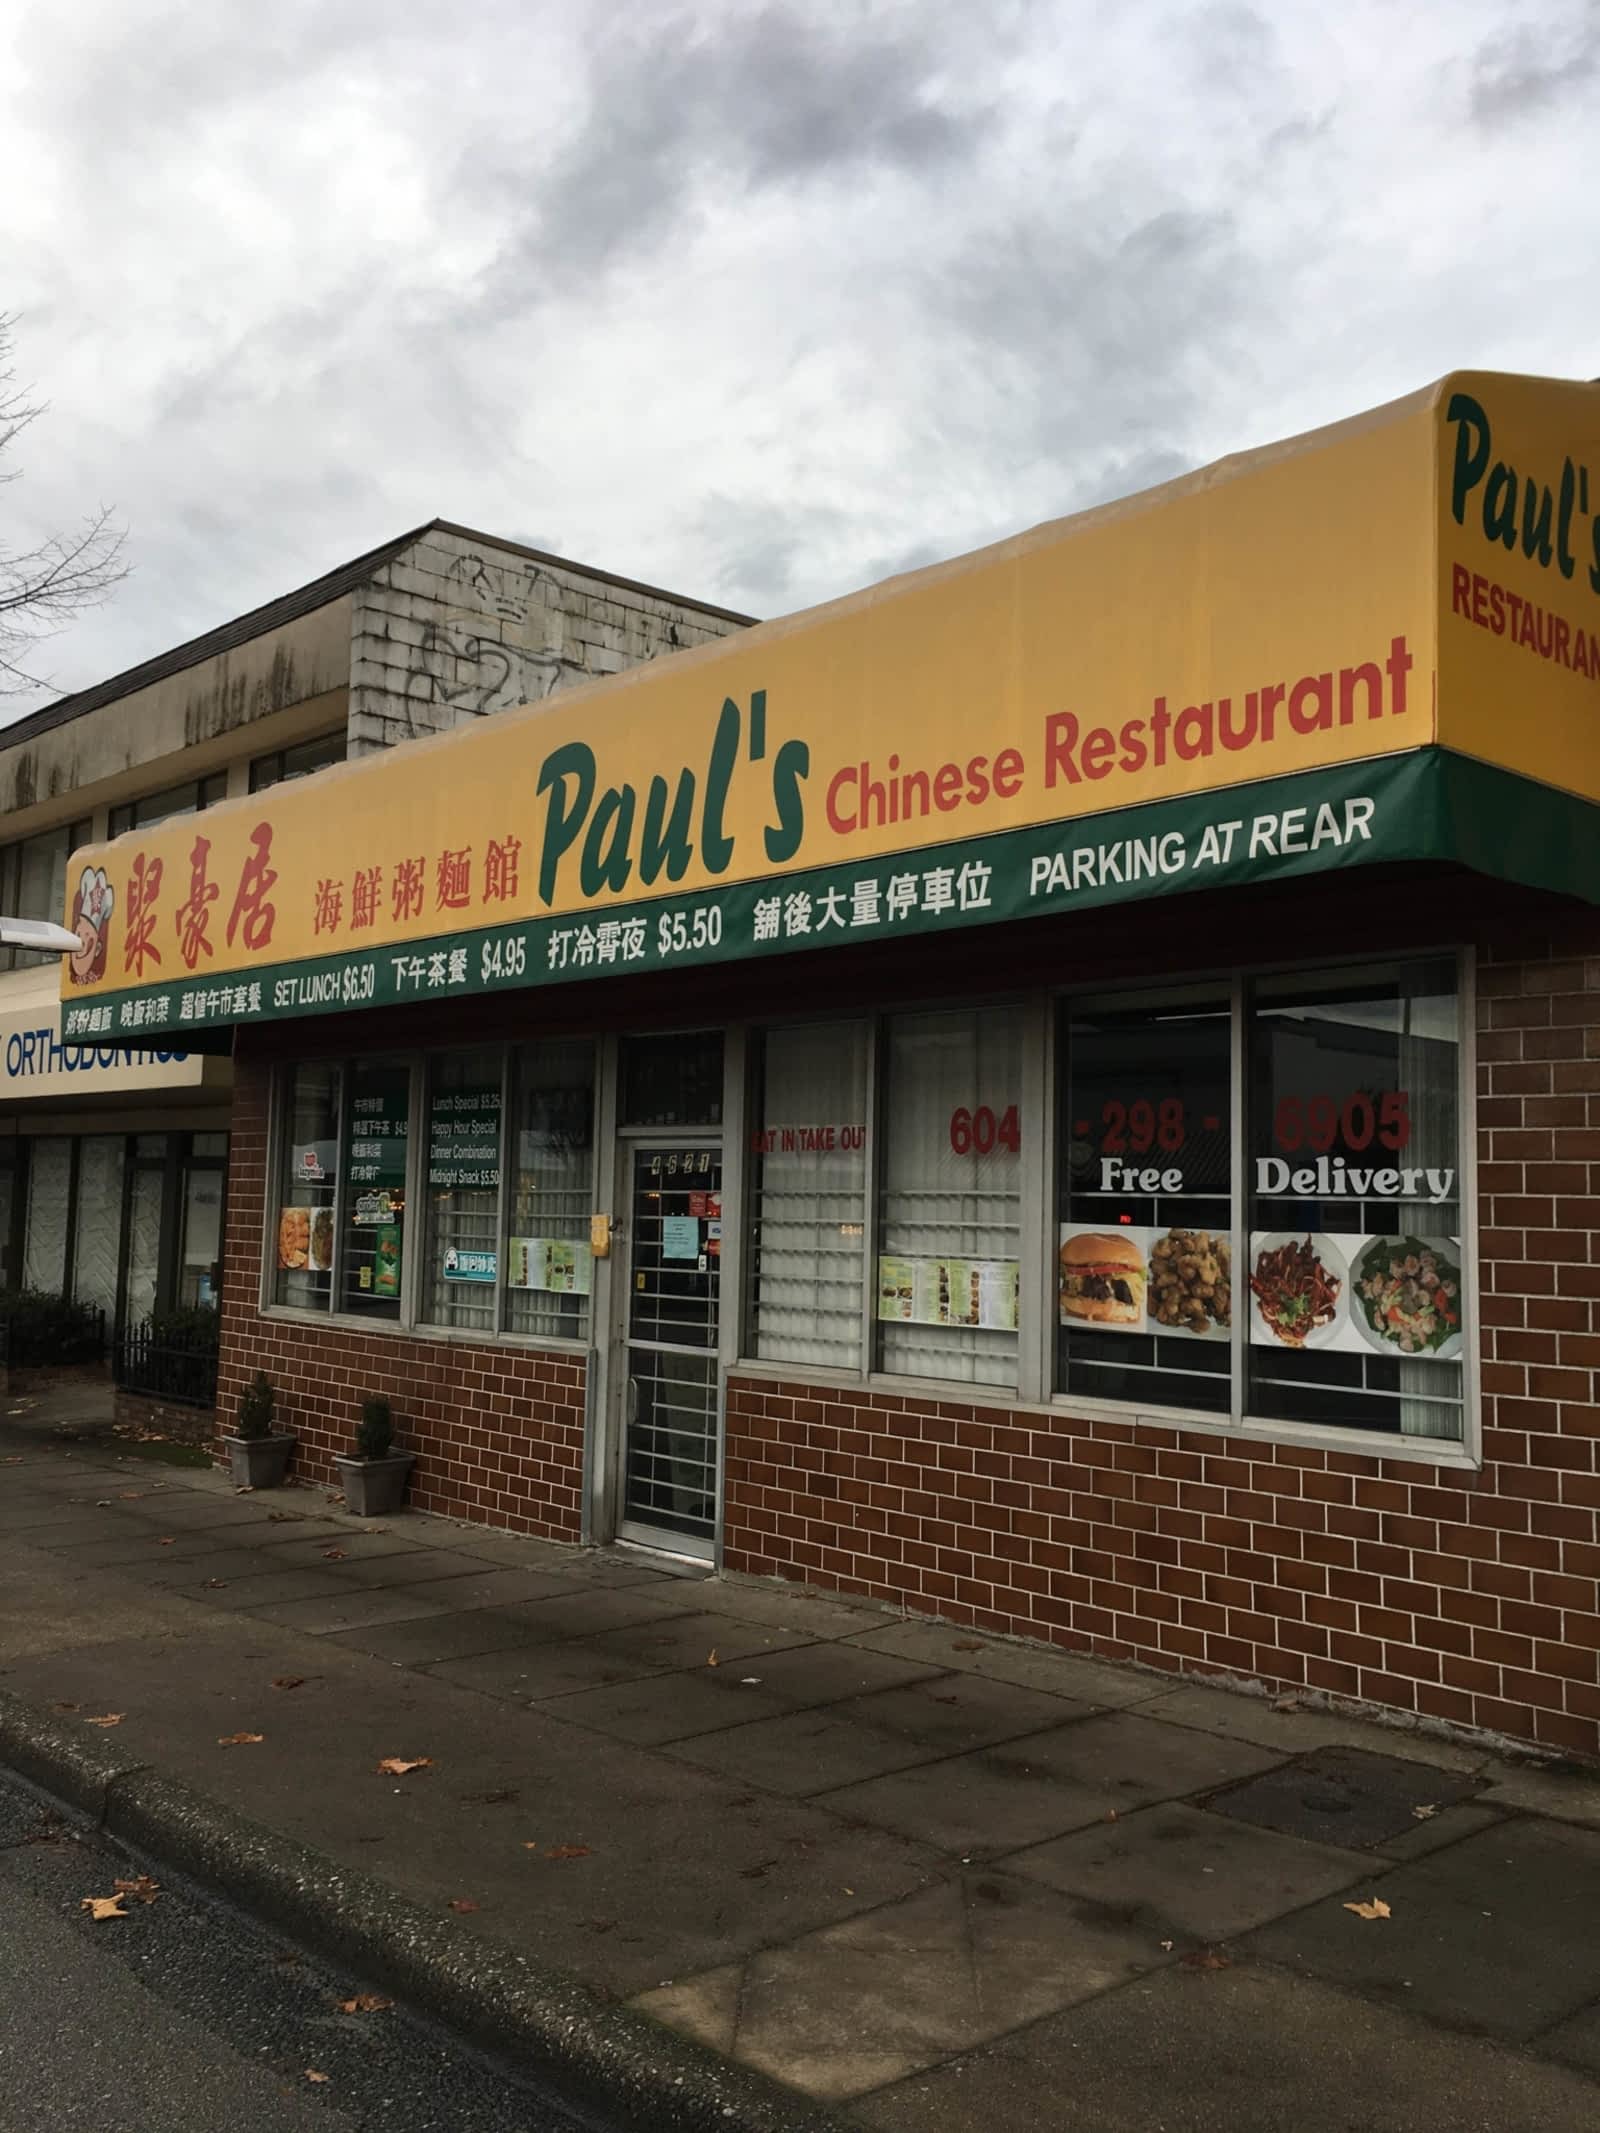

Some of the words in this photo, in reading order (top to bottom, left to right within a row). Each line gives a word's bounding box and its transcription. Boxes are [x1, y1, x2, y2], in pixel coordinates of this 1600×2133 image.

[826, 747, 1025, 835] Chinese
[1044, 635, 1413, 789] Restaurant
[535, 689, 809, 907] Paul's
[1029, 830, 1187, 897] PARKING
[1192, 820, 1243, 870] AT
[1248, 796, 1376, 860] REAR
[313, 834, 522, 936] 海鮮粥麵館
[657, 904, 723, 959] $5.50
[273, 978, 298, 1008] SET
[299, 971, 340, 1004] LUNCH
[342, 962, 376, 1005] $6.50
[391, 947, 468, 991] 下午茶餐
[480, 936, 527, 984] $4.95
[432, 1118, 453, 1138] Happy
[454, 1119, 471, 1134] Hour
[472, 1118, 497, 1137] Special
[751, 1130, 777, 1153] EAT
[782, 1128, 796, 1152] IN
[798, 1127, 836, 1151] TAKE
[950, 1104, 1021, 1155] 604
[1102, 1098, 1185, 1153] 298
[1274, 1089, 1410, 1153] 6905
[429, 1168, 457, 1187] Midnight
[458, 1168, 480, 1184] Snack
[431, 1144, 452, 1159] Dinner
[453, 1143, 497, 1160] Combination
[1100, 1156, 1184, 1193] Free
[1255, 1155, 1455, 1204] Delivery
